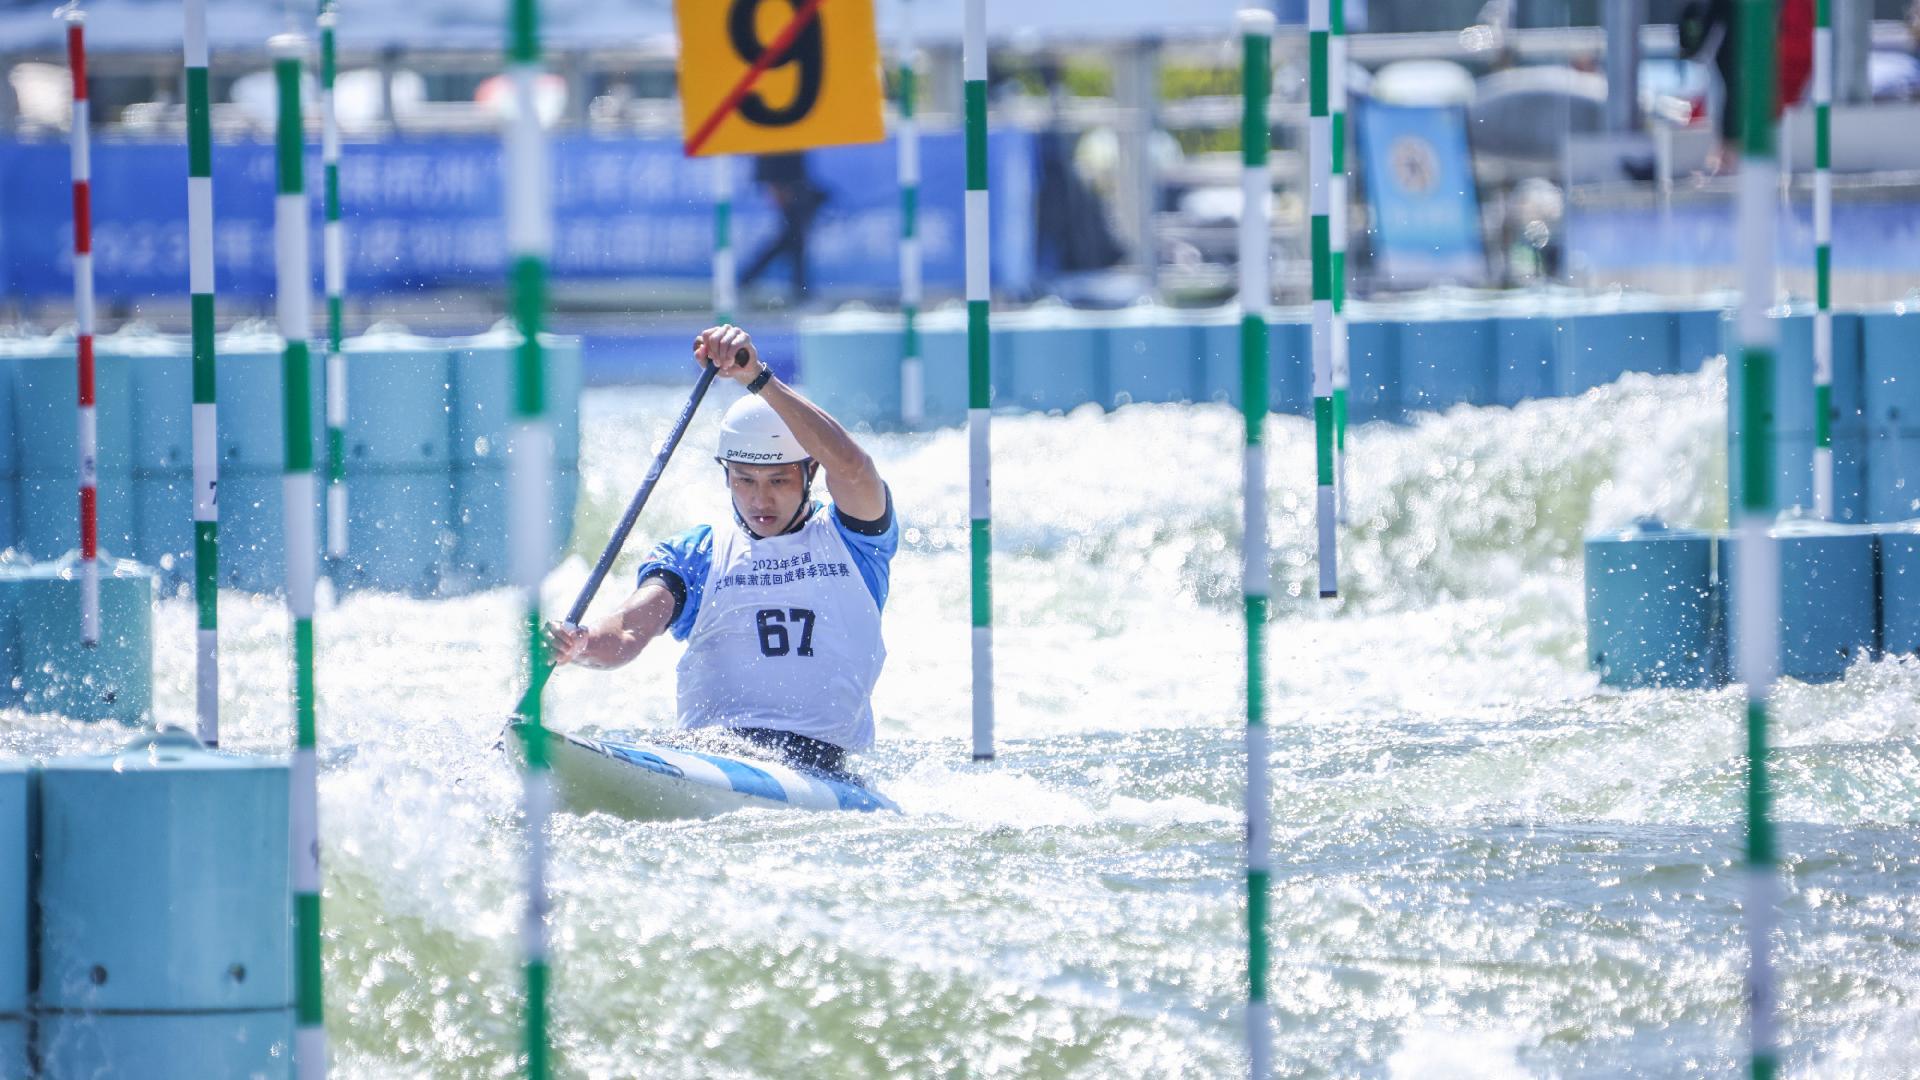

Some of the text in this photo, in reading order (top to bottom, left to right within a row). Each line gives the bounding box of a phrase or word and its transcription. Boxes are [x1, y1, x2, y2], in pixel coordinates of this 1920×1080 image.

[727, 0, 823, 127] 9
[726, 449, 784, 461] galasport
[752, 551, 812, 571] 2023年全国
[756, 608, 816, 657] 67
